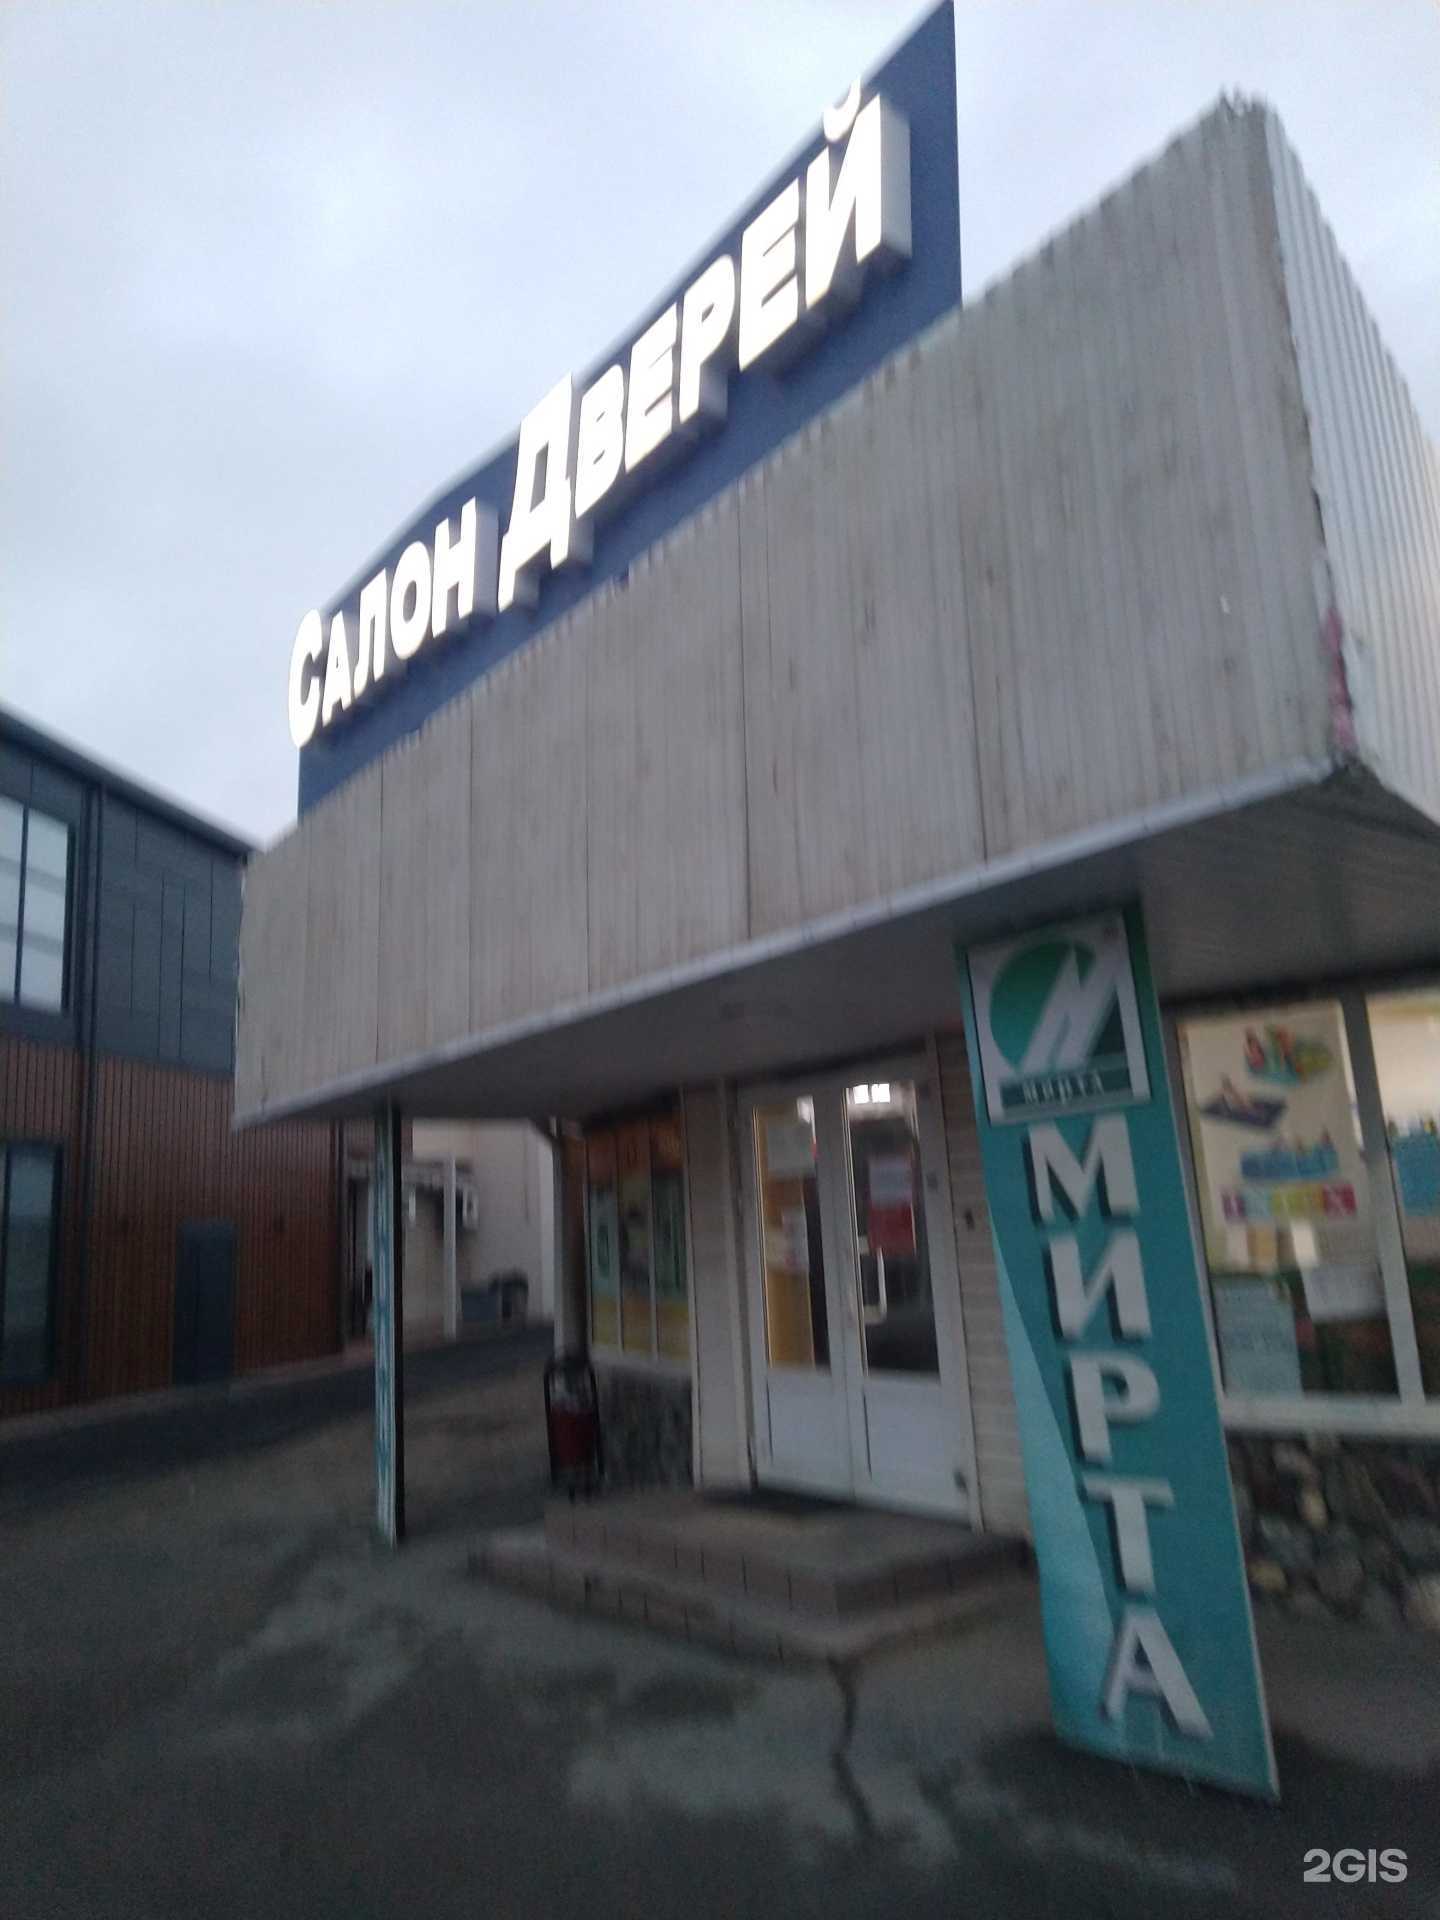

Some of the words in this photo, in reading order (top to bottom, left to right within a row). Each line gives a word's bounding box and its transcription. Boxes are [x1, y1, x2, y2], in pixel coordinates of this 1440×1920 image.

[288, 497, 480, 748] САЛОН
[498, 75, 884, 613] ДВЕРЕЙ
[1025, 1112, 1214, 1741] МИРТА
